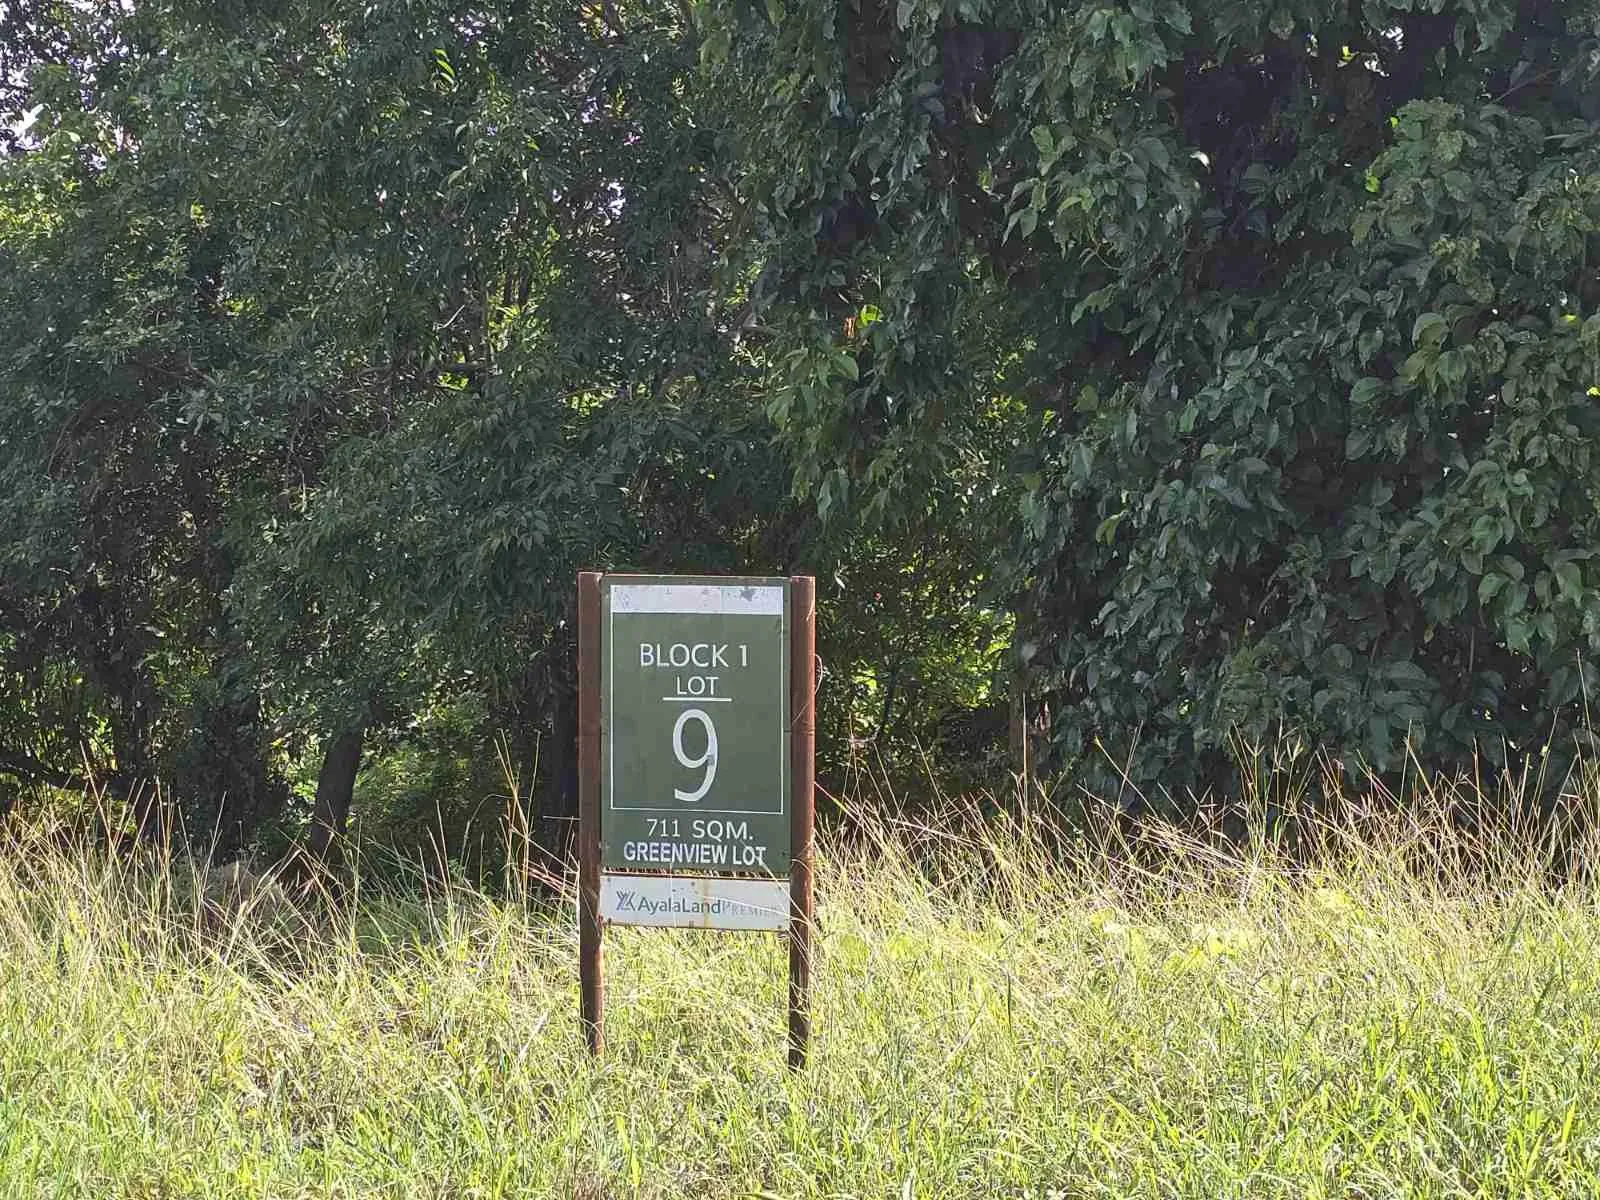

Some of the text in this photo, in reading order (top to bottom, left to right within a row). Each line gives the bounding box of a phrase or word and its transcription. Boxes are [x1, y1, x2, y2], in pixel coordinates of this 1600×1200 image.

[639, 643, 749, 668] BLOCK 1
[676, 676, 719, 695] LOT
[672, 708, 718, 802] 9
[646, 818, 754, 842] 711 SQM.
[623, 841, 767, 866] GREENVIEW LOT
